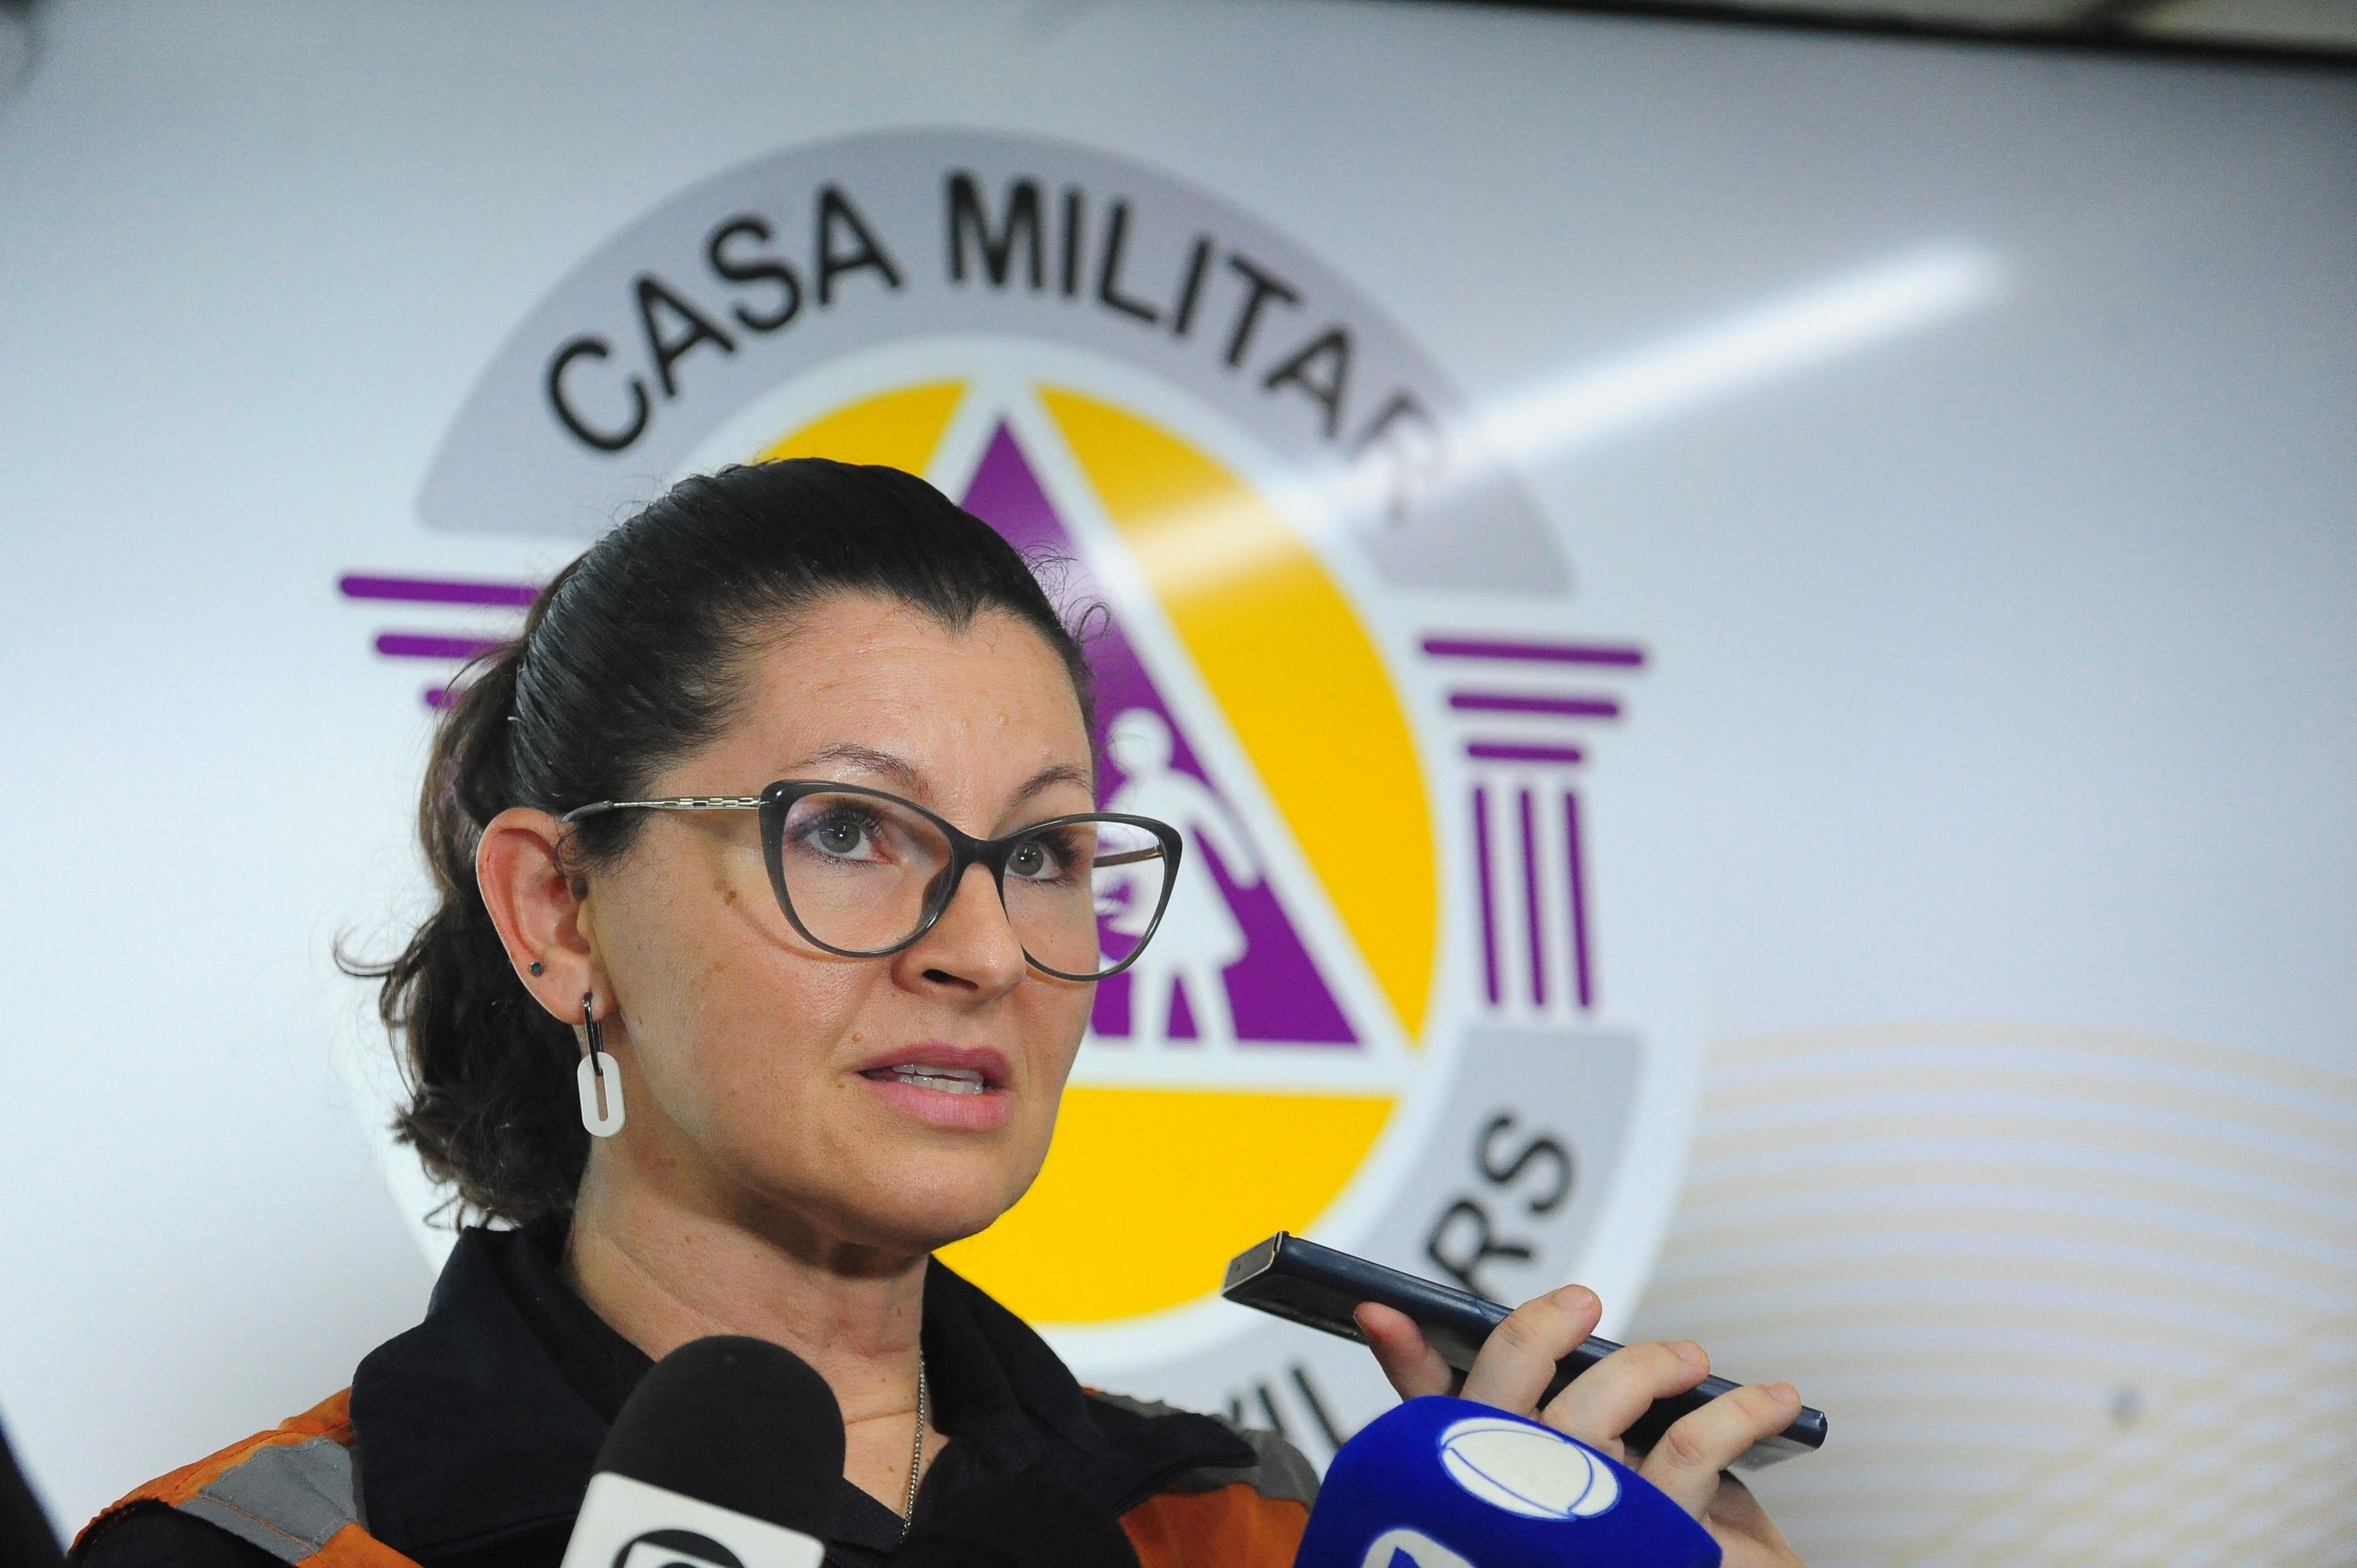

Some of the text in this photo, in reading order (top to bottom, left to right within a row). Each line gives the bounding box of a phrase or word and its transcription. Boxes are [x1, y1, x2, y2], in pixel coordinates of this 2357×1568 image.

[546, 168, 1446, 523] CASA MILITAR
[1425, 1114, 1573, 1302] RS
